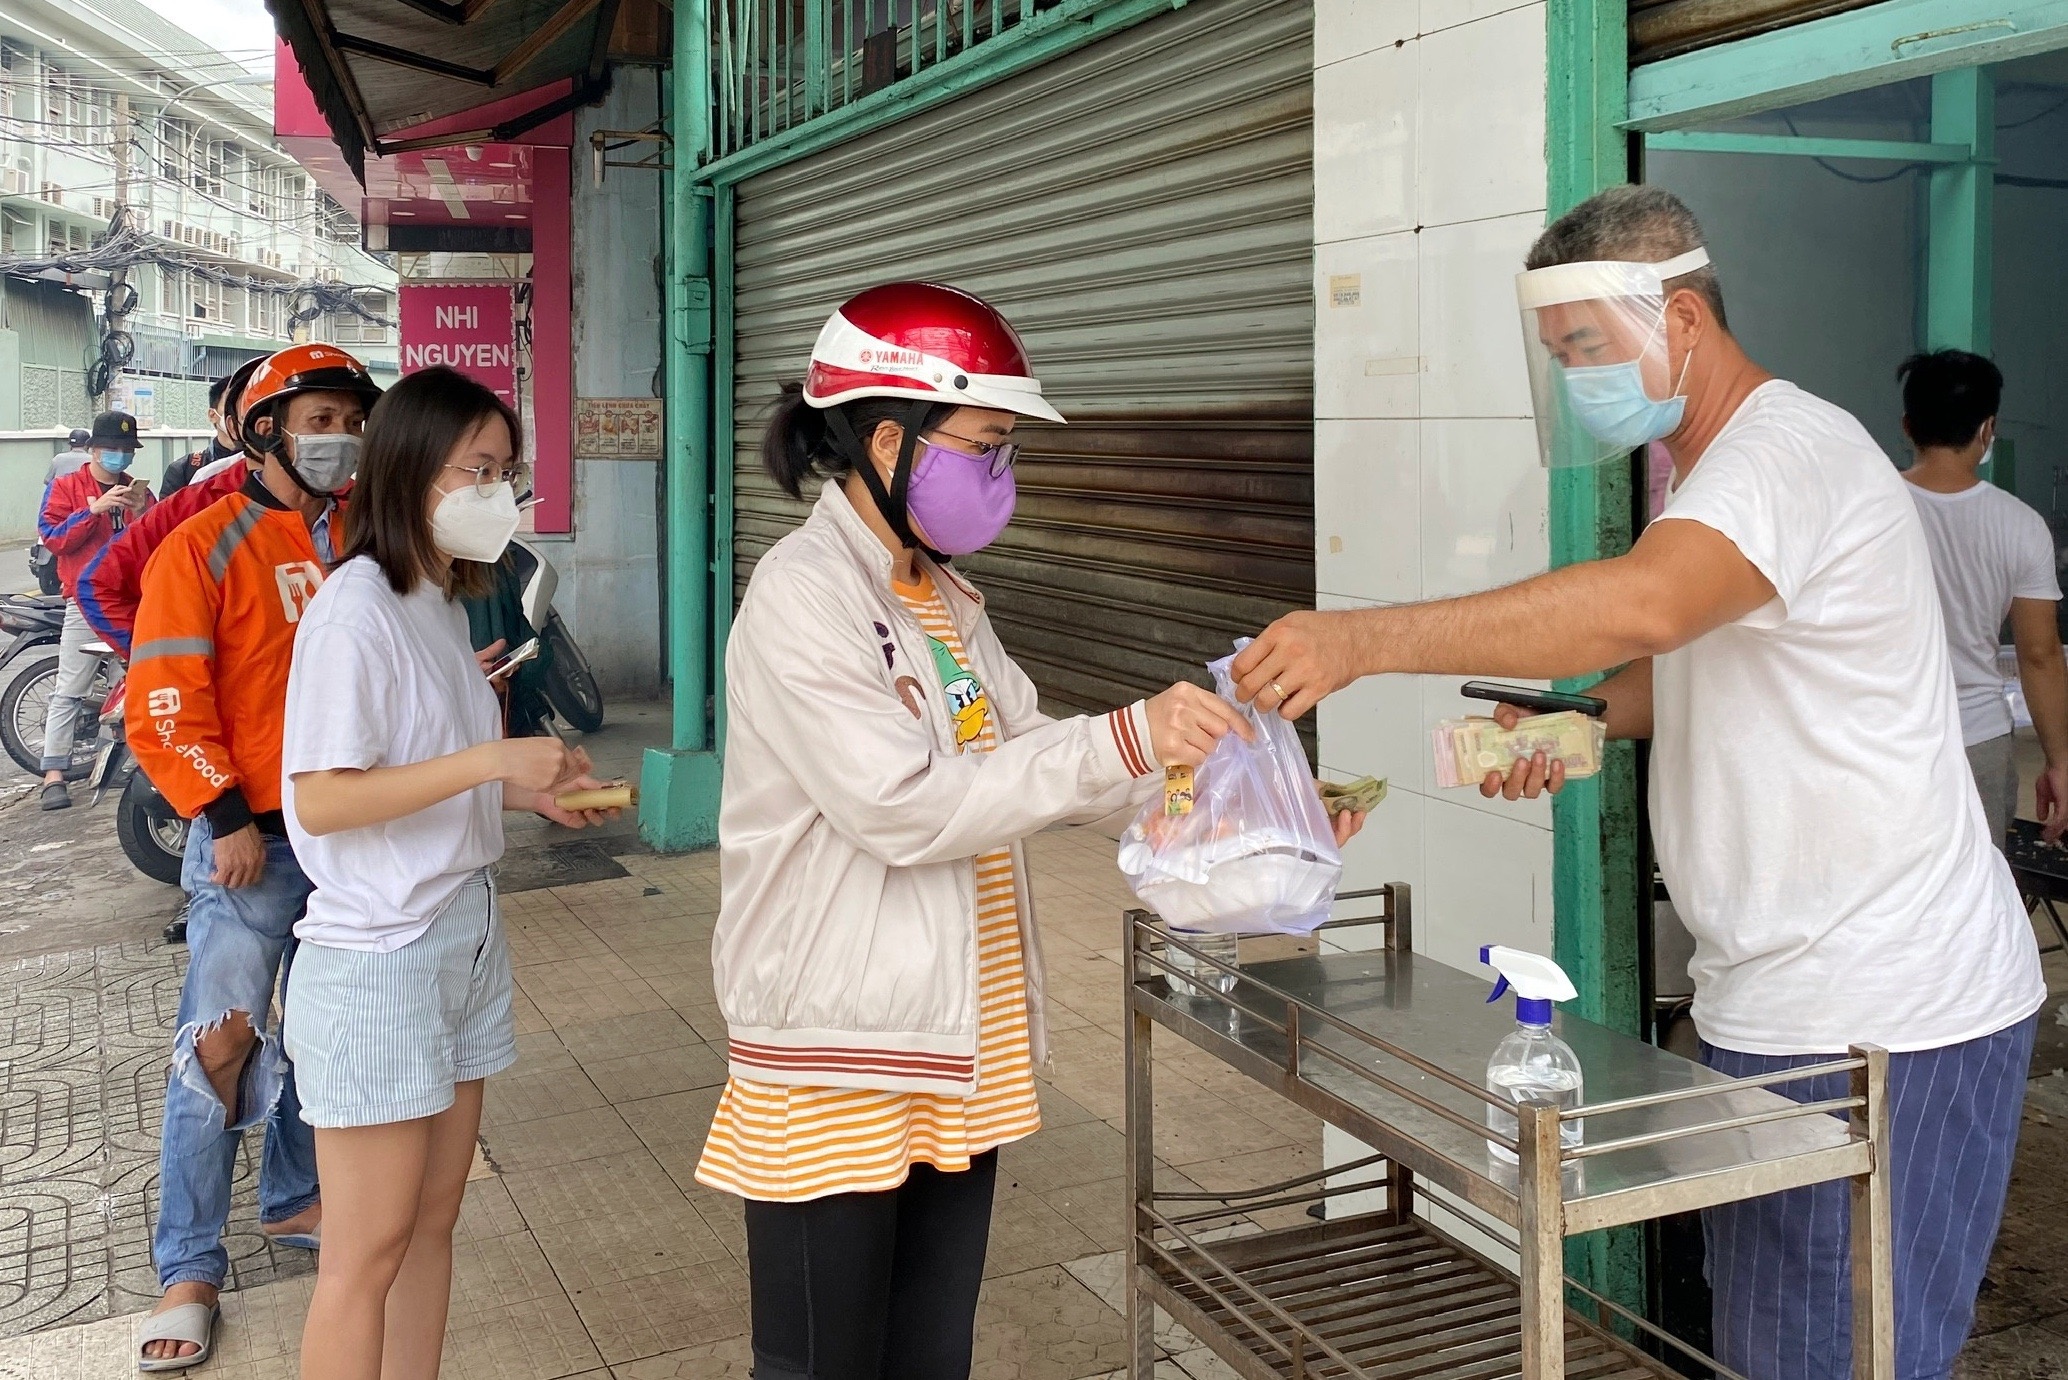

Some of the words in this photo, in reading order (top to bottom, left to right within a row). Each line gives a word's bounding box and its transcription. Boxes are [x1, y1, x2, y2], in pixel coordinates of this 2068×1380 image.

[435, 305, 478, 329] NHI
[405, 343, 509, 367] NGUYEN
[876, 351, 923, 365] YAMAHA
